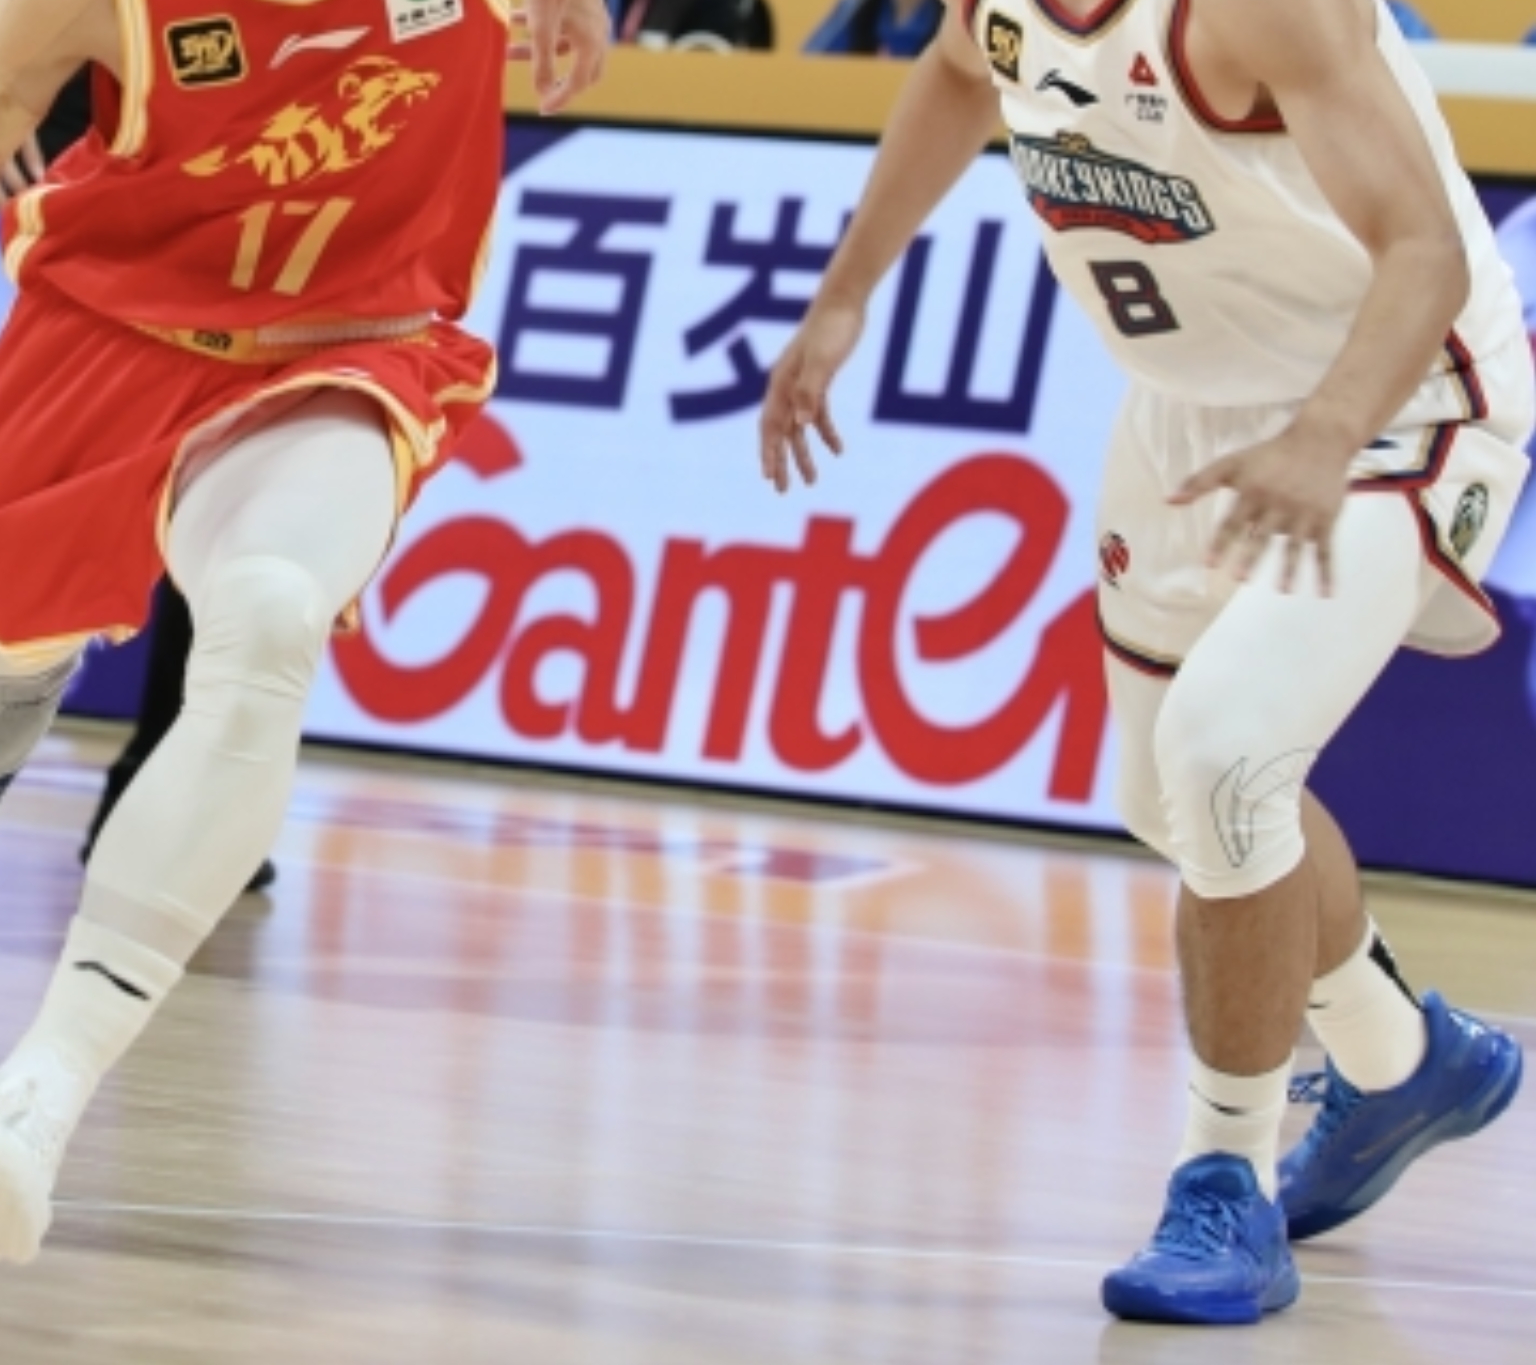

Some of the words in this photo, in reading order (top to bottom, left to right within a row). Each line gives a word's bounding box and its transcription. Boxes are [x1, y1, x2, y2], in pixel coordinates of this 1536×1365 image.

[230, 197, 355, 296] 17
[494, 186, 1064, 435] 百岁山
[1087, 260, 1181, 337] 8
